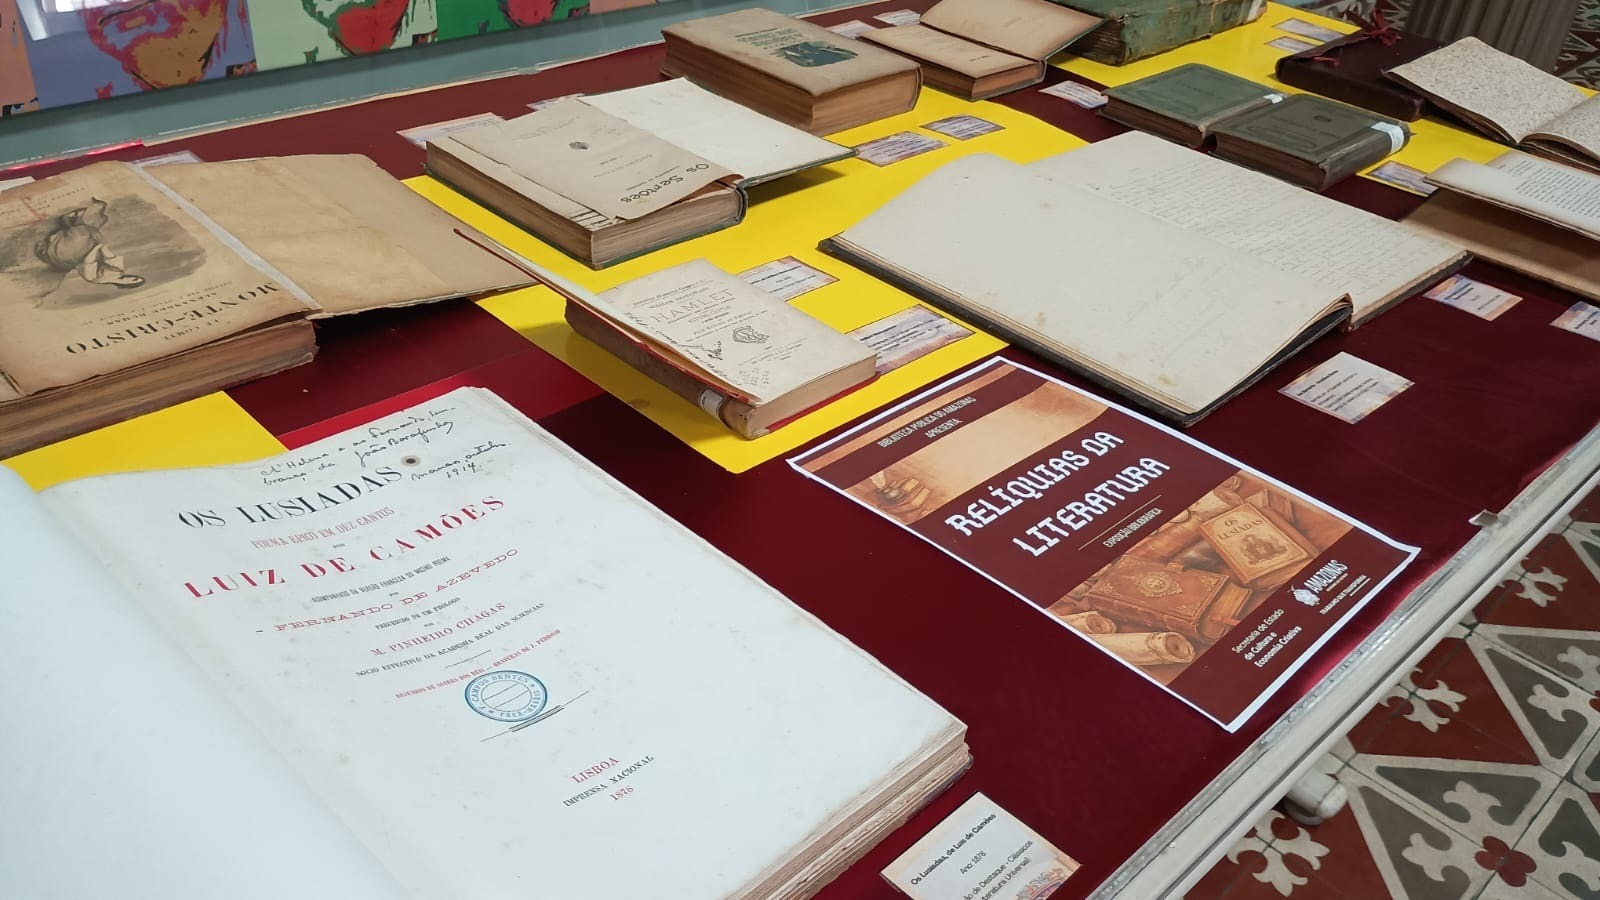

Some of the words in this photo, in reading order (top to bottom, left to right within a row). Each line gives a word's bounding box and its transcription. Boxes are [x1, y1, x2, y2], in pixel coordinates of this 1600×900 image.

[686, 162, 710, 173] Os
[66, 282, 280, 355] MONTE-CRISTO
[650, 288, 733, 322] HAMLET
[877, 428, 914, 448] BIBLIOTECA
[942, 396, 977, 414] AMAZONAS
[925, 418, 963, 439] APRESENTA
[178, 508, 226, 528] OS
[235, 466, 402, 524] LUSIADAS
[944, 449, 1090, 537] RELÍQUIAS
[1081, 431, 1124, 457] DA
[251, 536, 288, 549] POEMA
[320, 527, 335, 538] EM
[335, 520, 357, 534] DEZ
[355, 506, 395, 526] CANTOS
[1012, 457, 1171, 557] LITERATURA
[184, 568, 286, 598] LUIZ
[301, 557, 356, 578] DE
[369, 496, 504, 561] CAMÕES
[1103, 526, 1131, 549] EXPOSIÇÃO
[274, 603, 394, 632] FERNANDO
[401, 591, 429, 606] DE
[435, 549, 519, 593] AZEVEDO
[1304, 559, 1348, 594] AMAZONAS
[370, 648, 386, 657] M.
[388, 627, 454, 652] PINHEIRO
[456, 602, 506, 630] CHAGAS
[424, 651, 436, 659] DA
[437, 639, 474, 656] ACADEMIA
[474, 628, 495, 642] REAL
[495, 621, 510, 632] DAS
[1231, 630, 1261, 654] Secretaria
[1257, 622, 1268, 632] de
[1263, 609, 1285, 625] Estado
[1244, 651, 1254, 661] de
[1250, 636, 1273, 654] Cultura
[1254, 643, 1282, 668] Economia
[1279, 626, 1303, 645] Criativa
[563, 783, 608, 806] IMPRENSA
[609, 755, 654, 783] NACIONAL
[571, 757, 620, 783] LISBOA
[911, 876, 922, 885] Os
[946, 848, 956, 856] de
[965, 832, 974, 840] de
[972, 814, 996, 833] Camões
[972, 886, 981, 895] de
[979, 864, 1007, 888] Destaque
